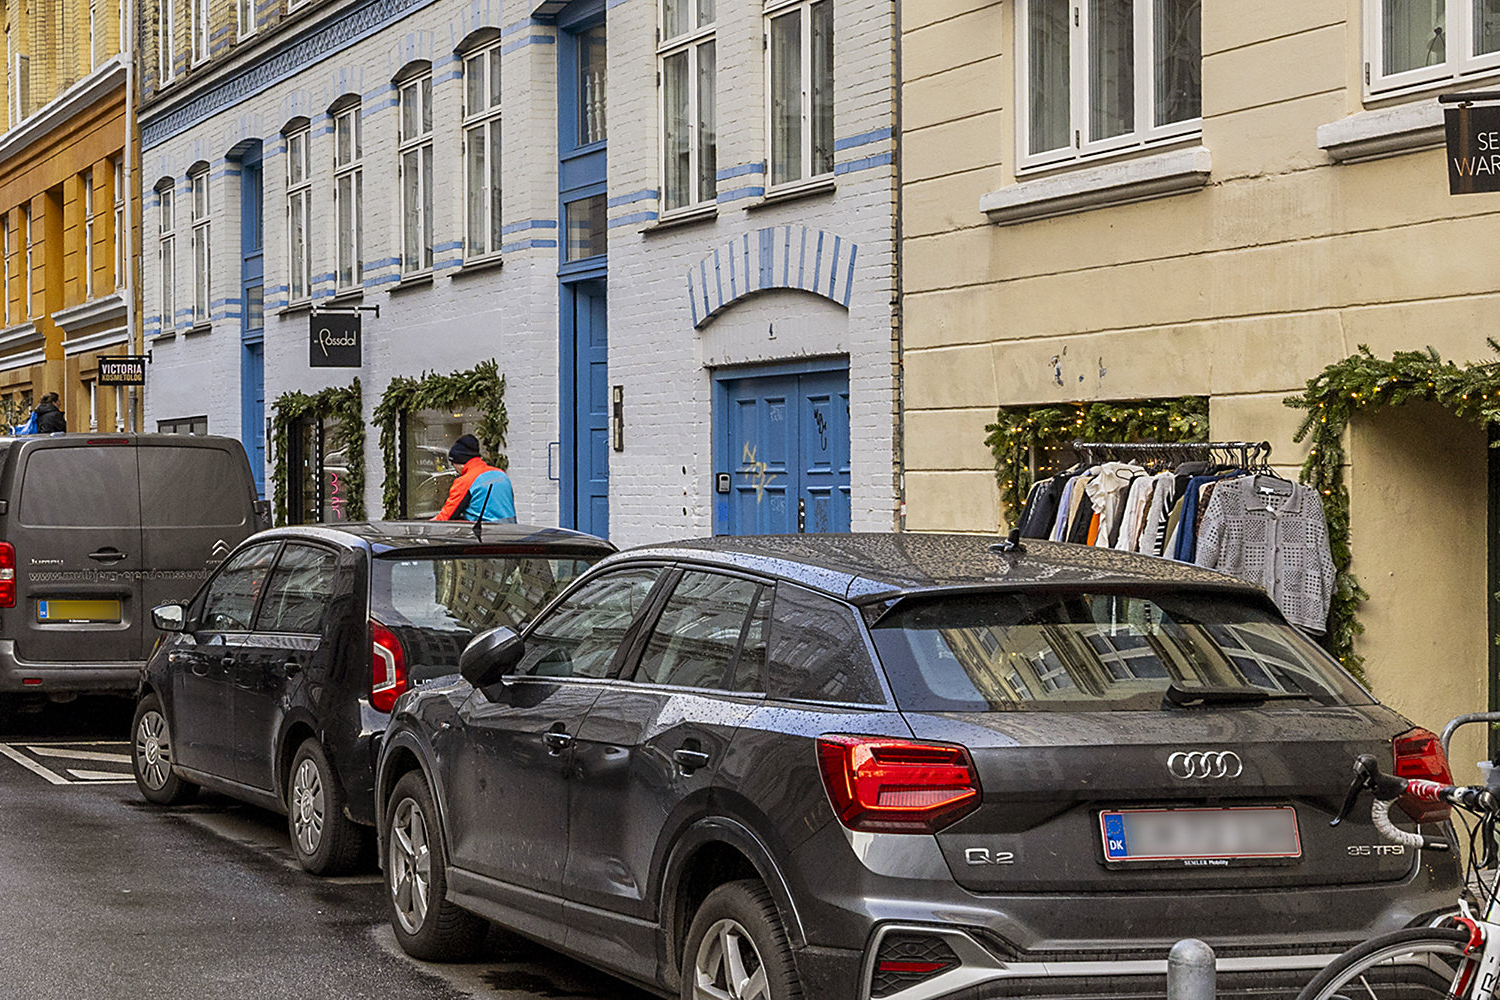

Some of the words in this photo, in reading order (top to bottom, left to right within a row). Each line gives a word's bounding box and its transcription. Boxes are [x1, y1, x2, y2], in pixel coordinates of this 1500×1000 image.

[101, 363, 142, 374] VICTORIA
[1109, 840, 1124, 851] DK
[1348, 845, 1371, 856] 35
[1373, 845, 1405, 856] TFSI
[965, 848, 1014, 865] Q2
